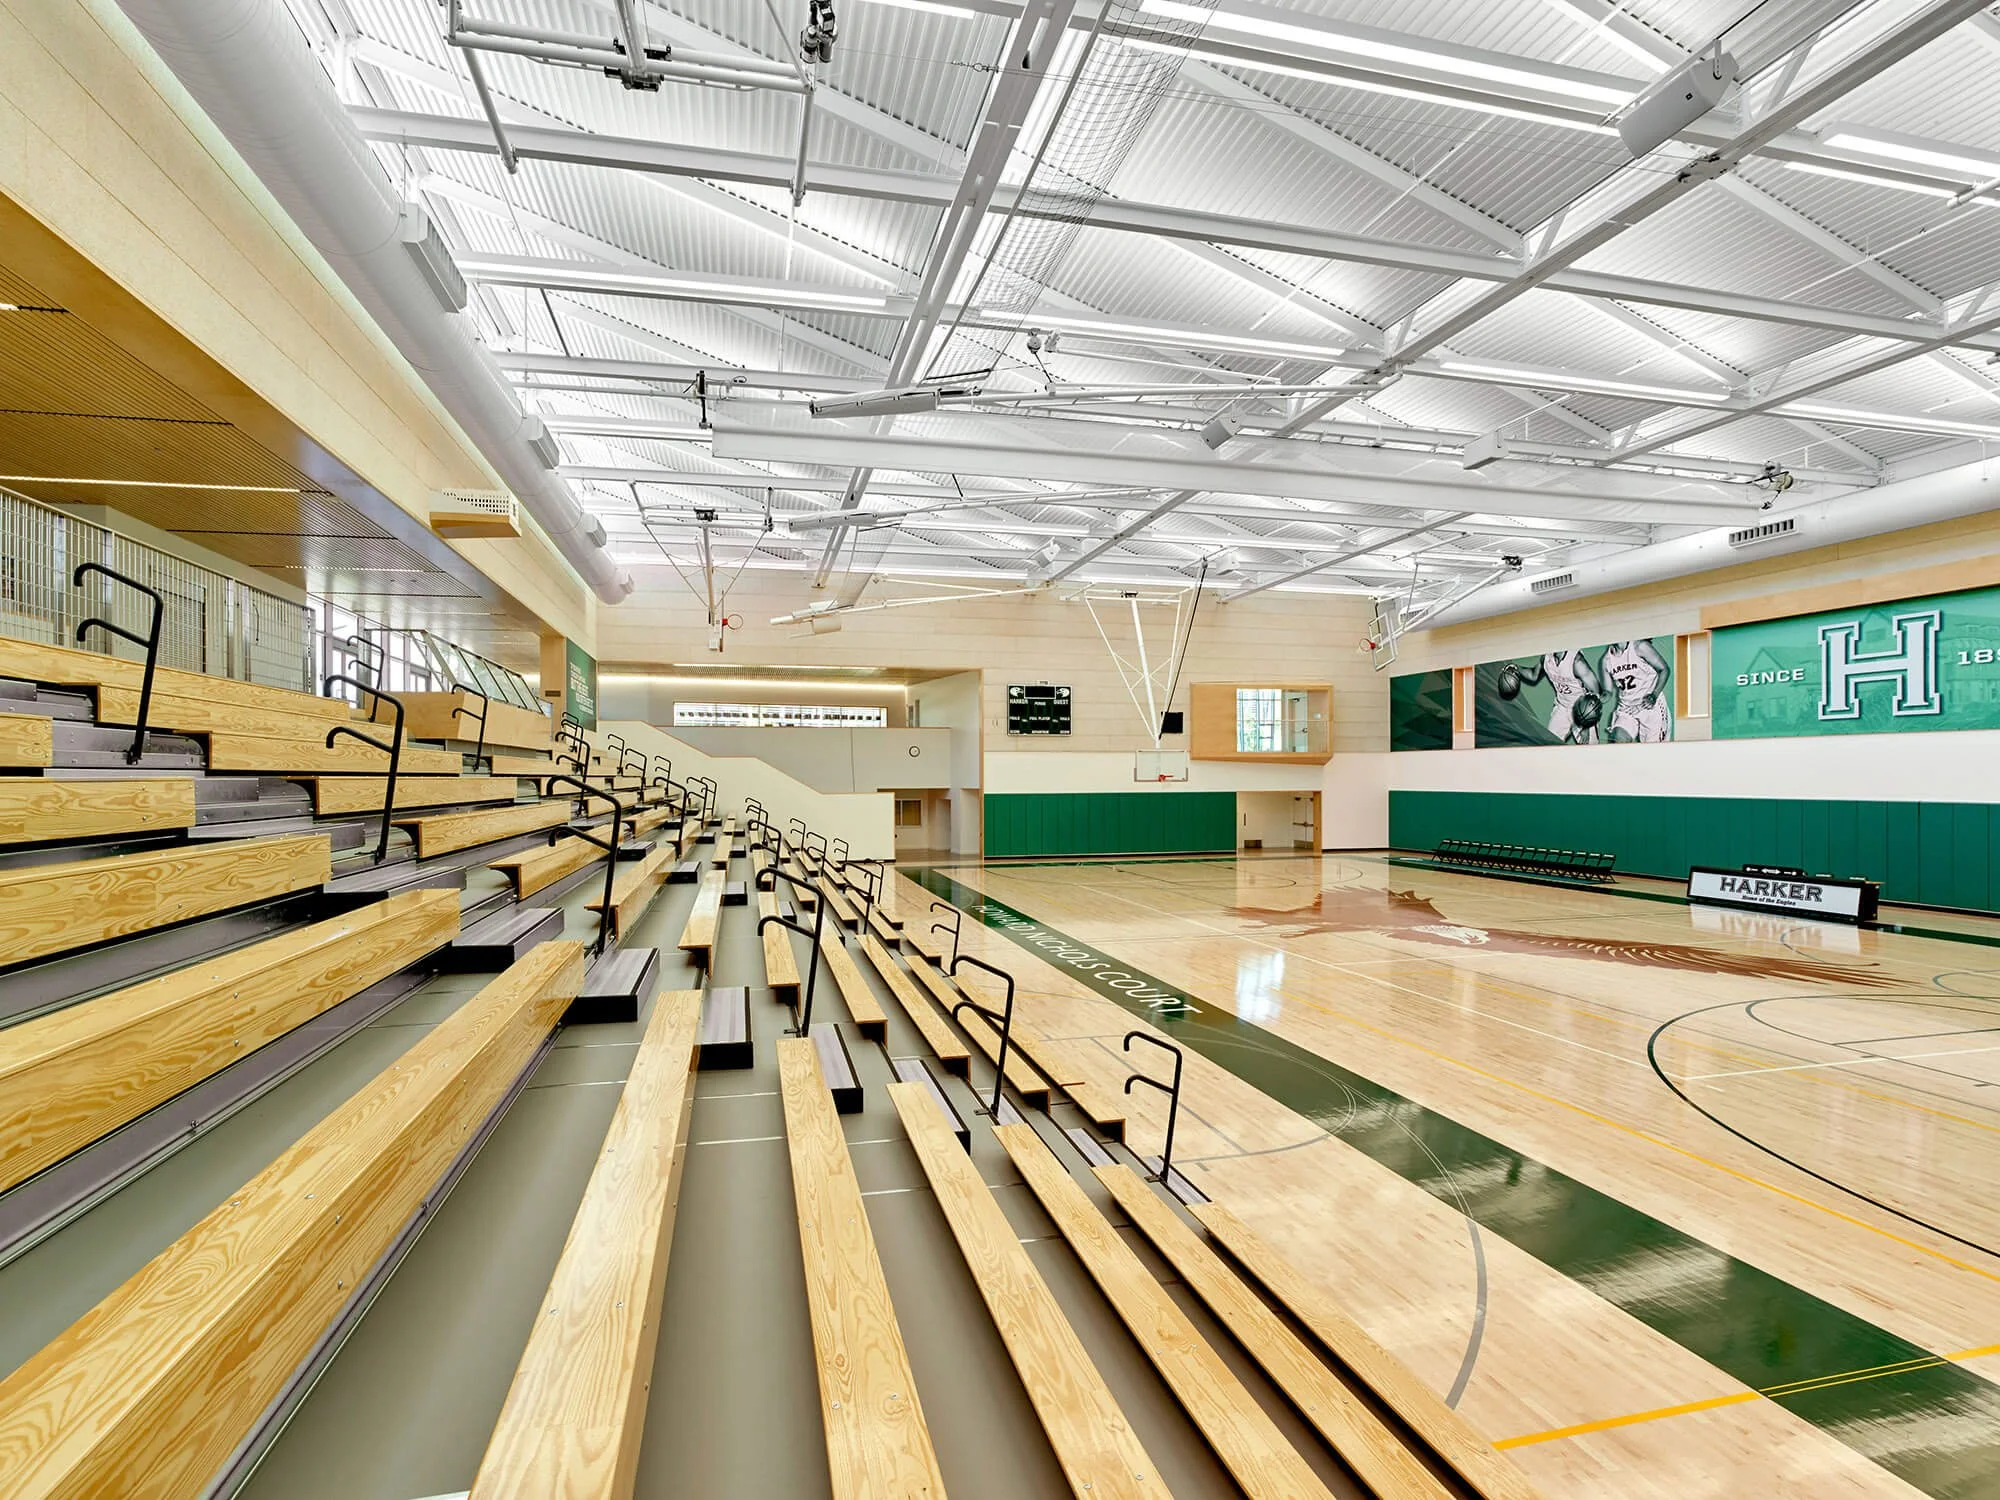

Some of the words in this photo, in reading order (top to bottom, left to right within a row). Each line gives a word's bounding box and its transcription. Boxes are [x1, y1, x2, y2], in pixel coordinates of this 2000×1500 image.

[1611, 663, 1638, 675] ARKER
[1736, 668, 1805, 686] SINCE
[1957, 648, 2000, 665] 18
[1818, 610, 1941, 720] H
[1719, 877, 1823, 902] HARKER
[1776, 898, 1796, 906] Eagles
[972, 905, 1037, 932] HOWARD
[1020, 932, 1111, 970] NICHOLS
[1093, 971, 1203, 1014] COURT
